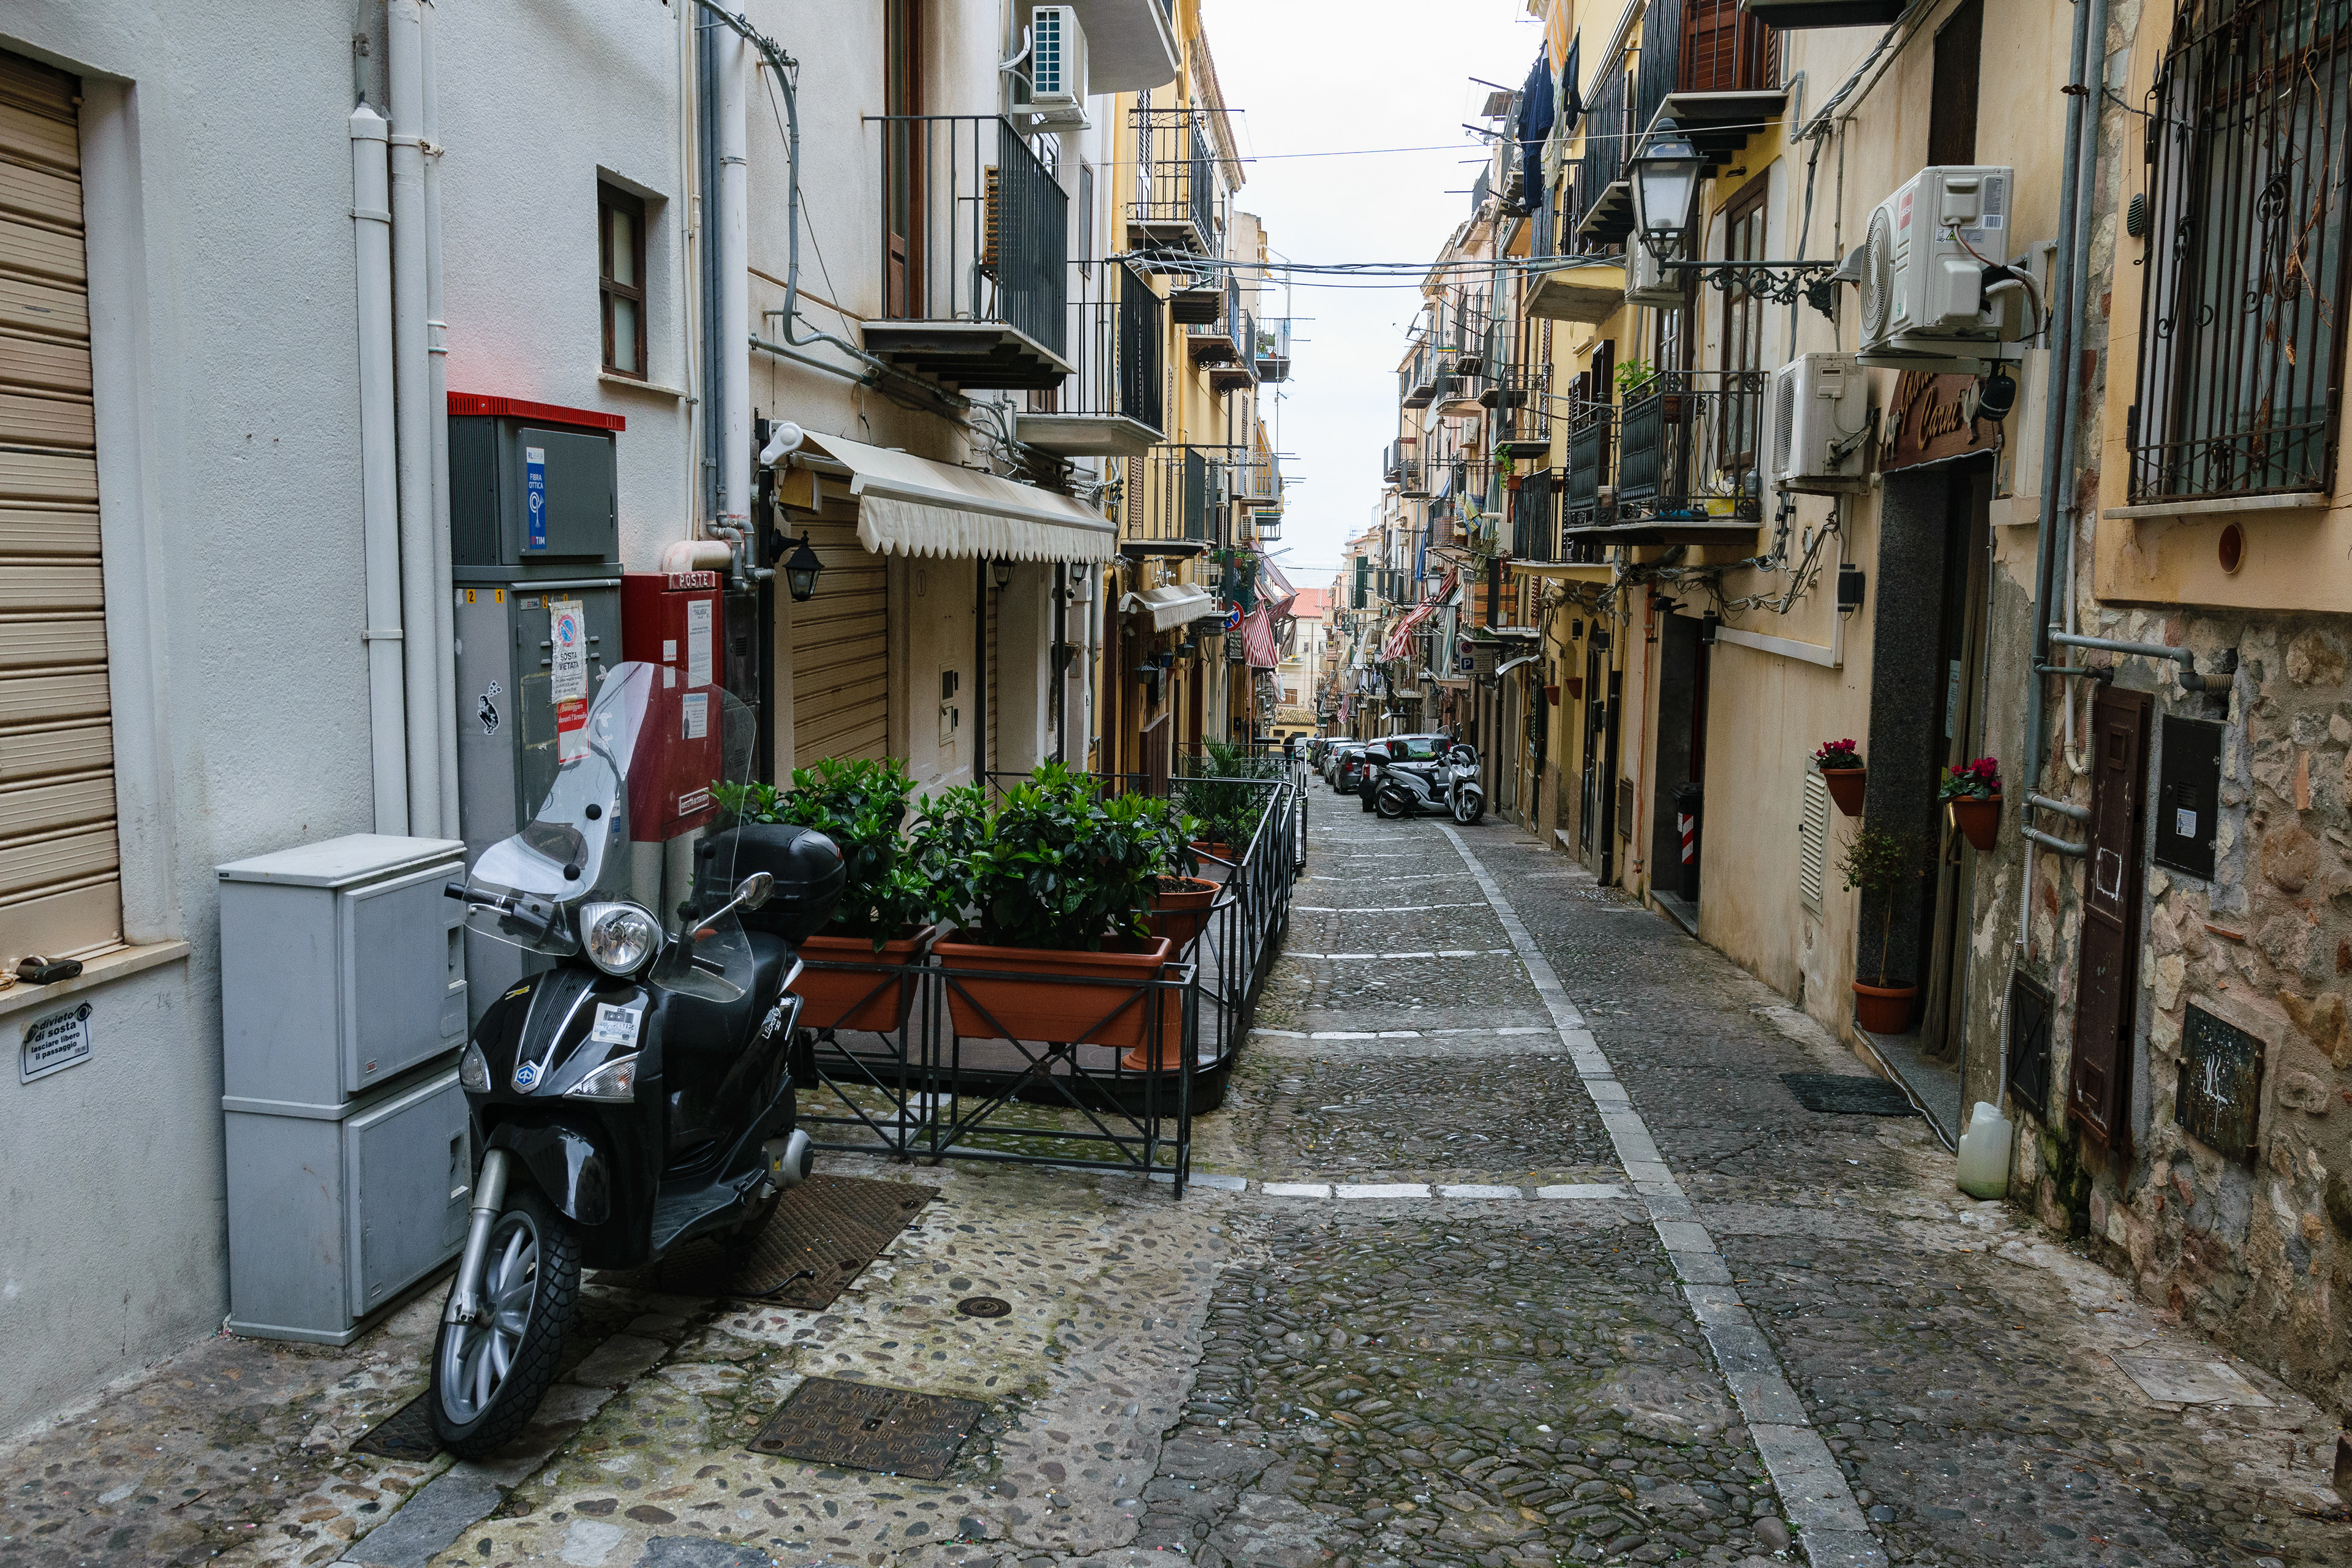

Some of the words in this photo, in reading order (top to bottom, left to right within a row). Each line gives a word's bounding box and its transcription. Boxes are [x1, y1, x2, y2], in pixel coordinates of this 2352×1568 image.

[536, 537, 545, 545] TIM
[679, 573, 708, 587] POSTE
[469, 591, 473, 602] 2
[497, 590, 502, 601] 1
[543, 597, 547, 608] 2
[560, 652, 578, 662] SOSTA
[559, 661, 579, 671] VIETATA
[1463, 659, 1471, 669] P
[40, 1012, 74, 1031] divieto
[762, 1007, 782, 1039] Liberty
[35, 1030, 45, 1042] di
[48, 1022, 76, 1038] sosta
[31, 1040, 59, 1054] lasciare
[61, 1032, 80, 1043] libero
[42, 1041, 77, 1060] passaggio
